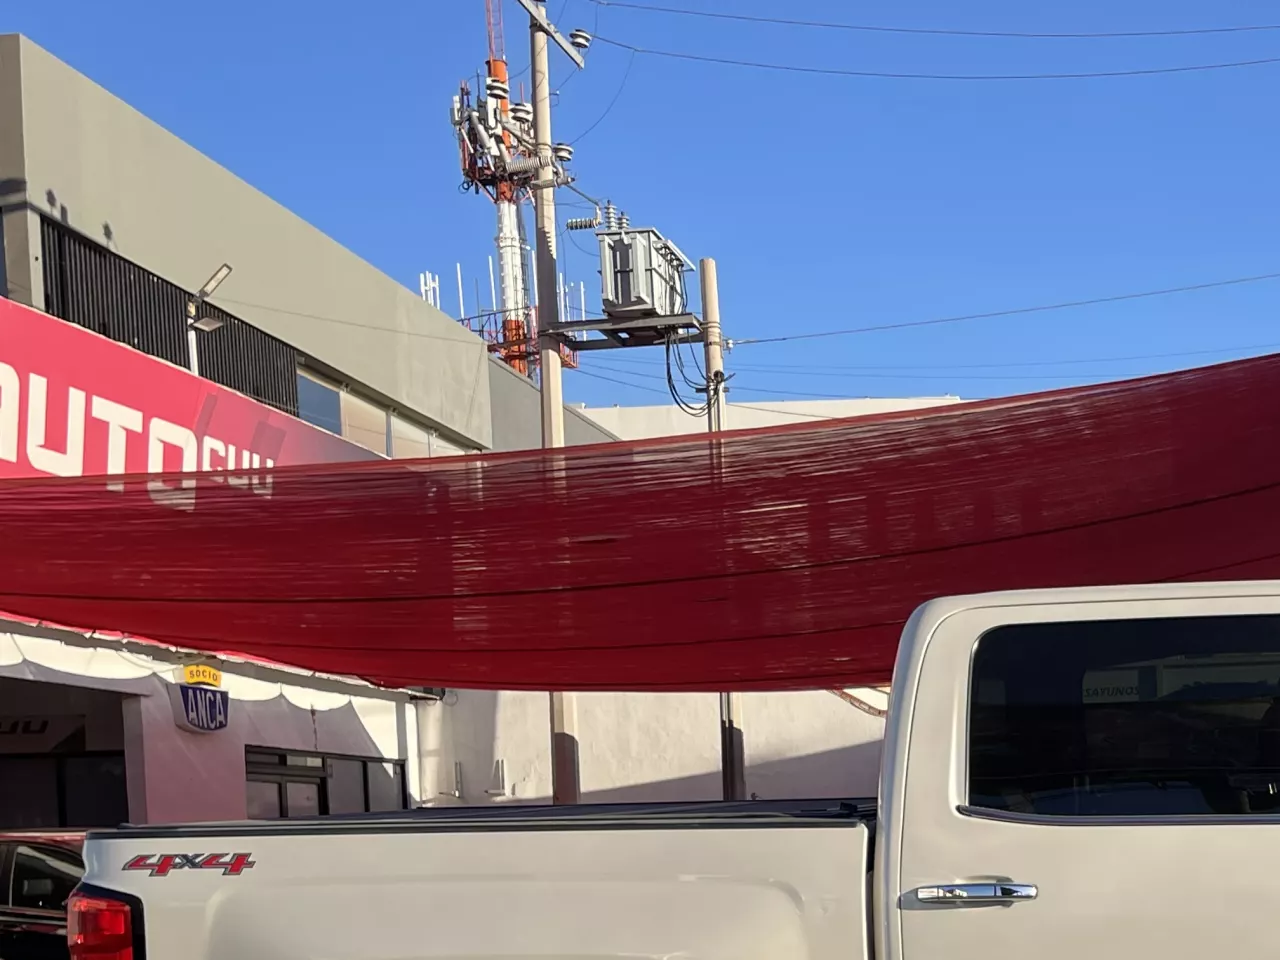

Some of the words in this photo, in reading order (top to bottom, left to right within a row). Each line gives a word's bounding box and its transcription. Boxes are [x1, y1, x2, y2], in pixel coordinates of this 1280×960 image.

[189, 669, 218, 682] SOCIO
[1082, 686, 1140, 698] SAYUNOS
[187, 688, 226, 729] ANCA
